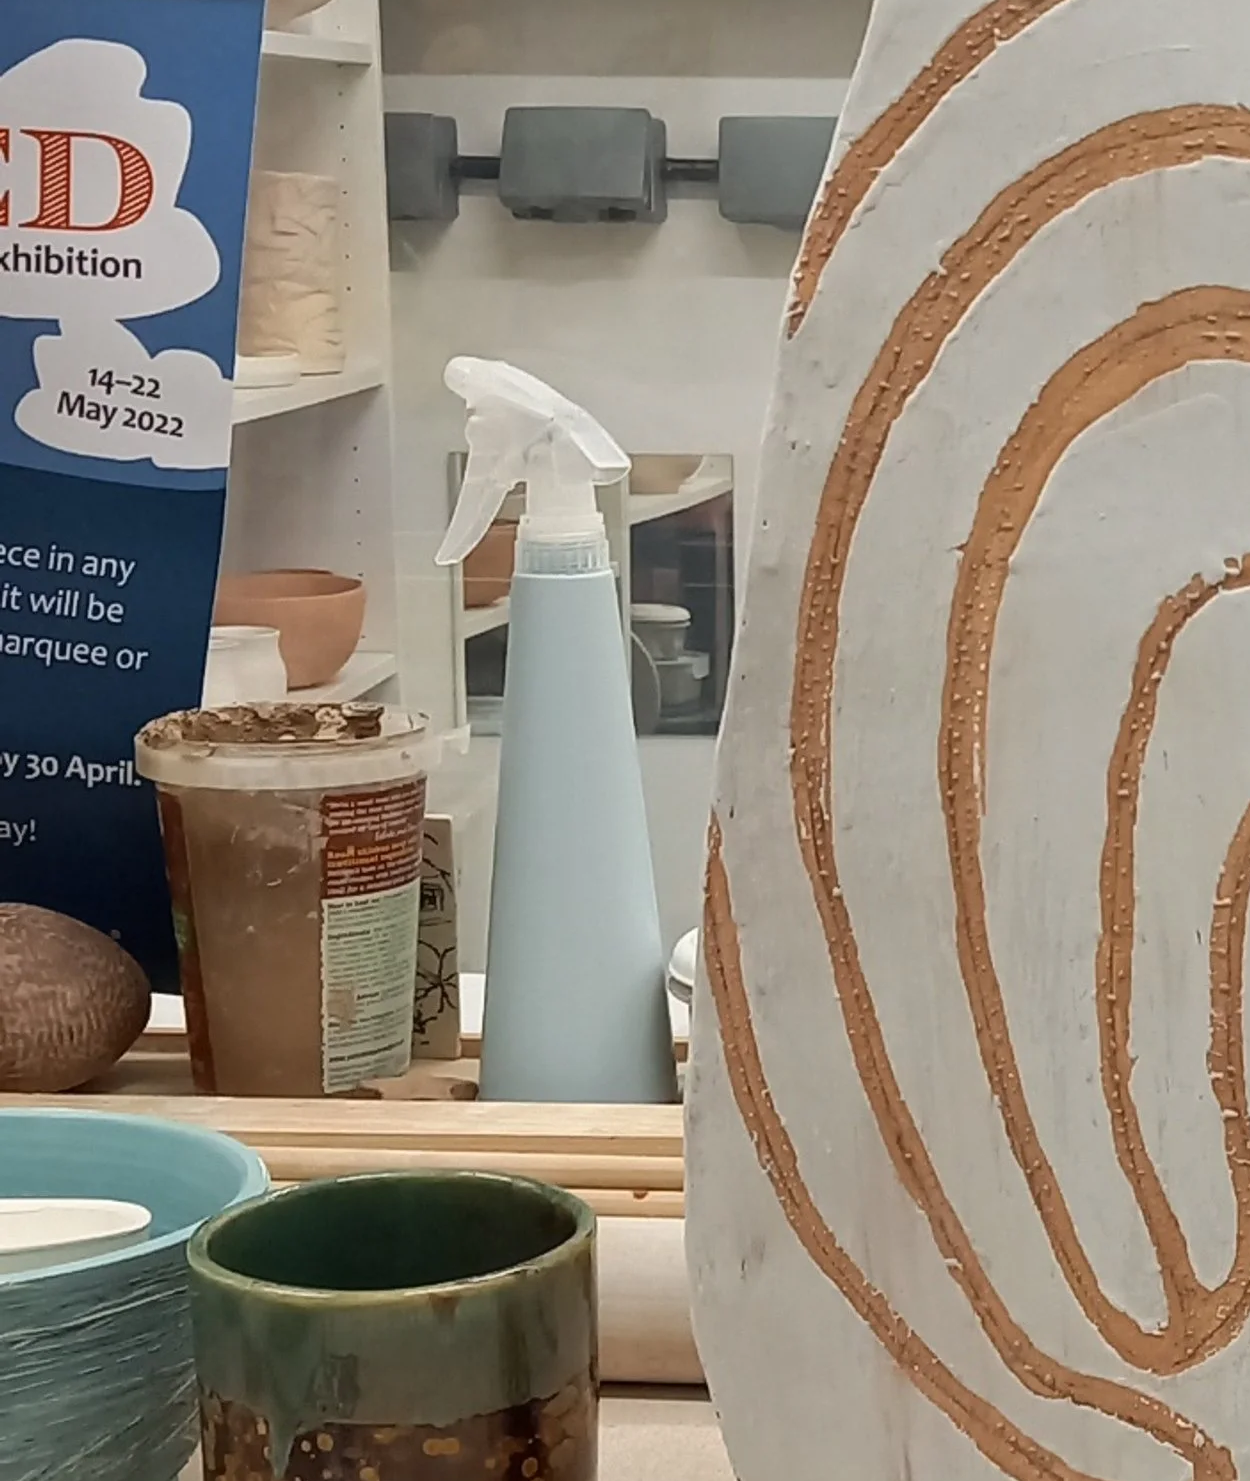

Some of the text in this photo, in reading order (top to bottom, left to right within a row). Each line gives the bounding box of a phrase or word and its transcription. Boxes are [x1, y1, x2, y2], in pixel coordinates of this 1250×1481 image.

[57, 390, 185, 438] May 2022
[48, 544, 75, 573] in
[81, 554, 137, 587] any
[1, 582, 125, 623] it will be
[0, 632, 149, 671] arquee or
[0, 751, 142, 788] y 30 April.
